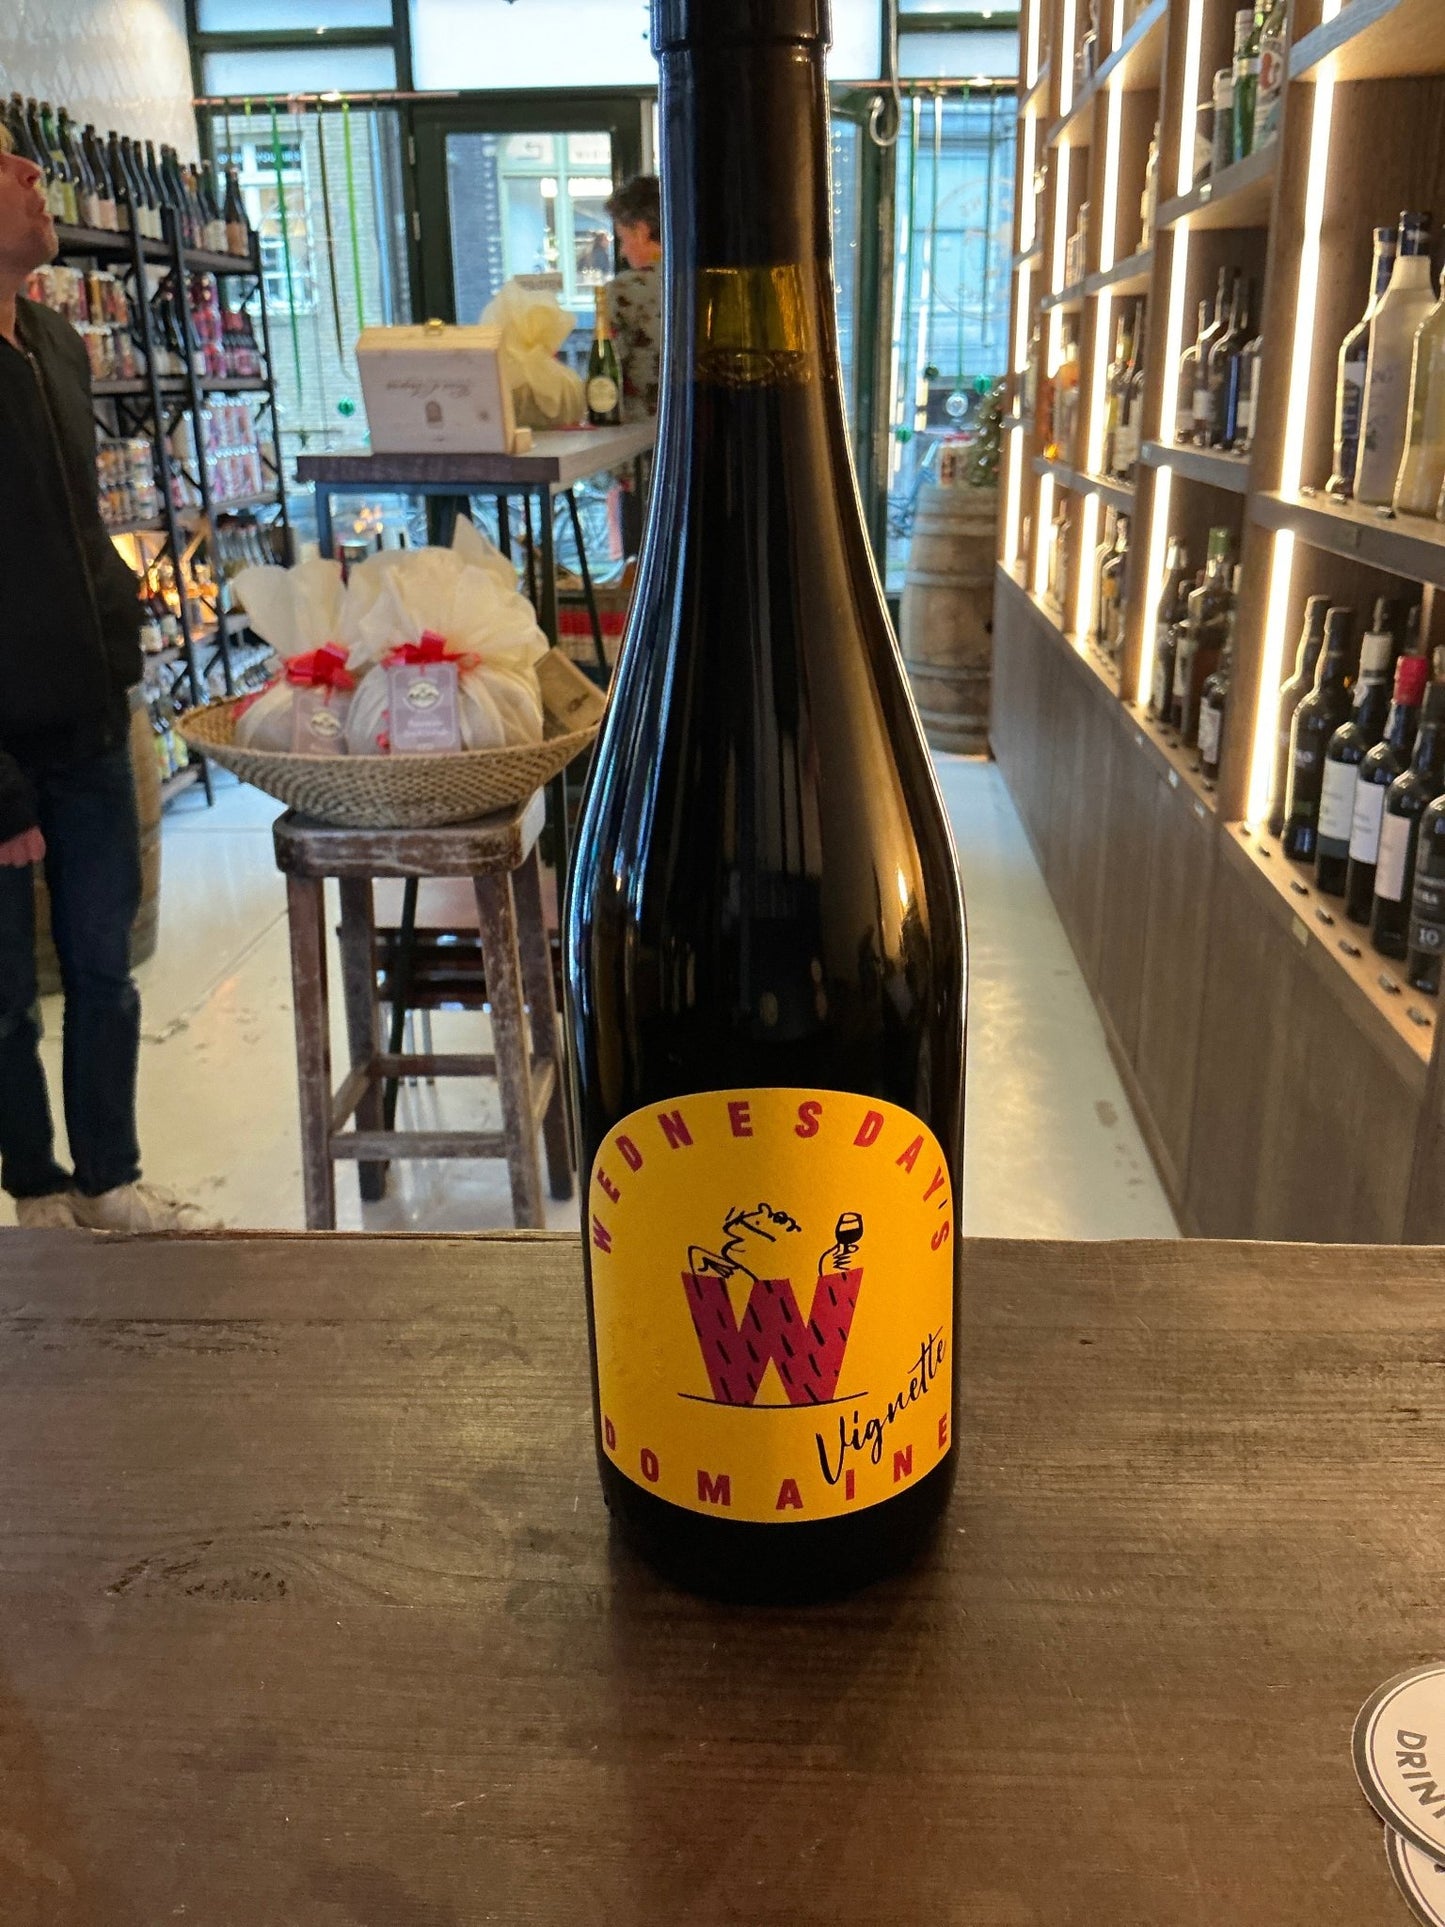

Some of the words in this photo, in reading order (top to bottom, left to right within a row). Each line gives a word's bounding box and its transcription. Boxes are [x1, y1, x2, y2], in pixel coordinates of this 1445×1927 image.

[592, 1100, 951, 1254] WEDNESDAY'S
[604, 1413, 948, 1510] DOMAINE
[815, 1326, 946, 1486] Vignette
[1395, 1729, 1445, 1819] DRIN
